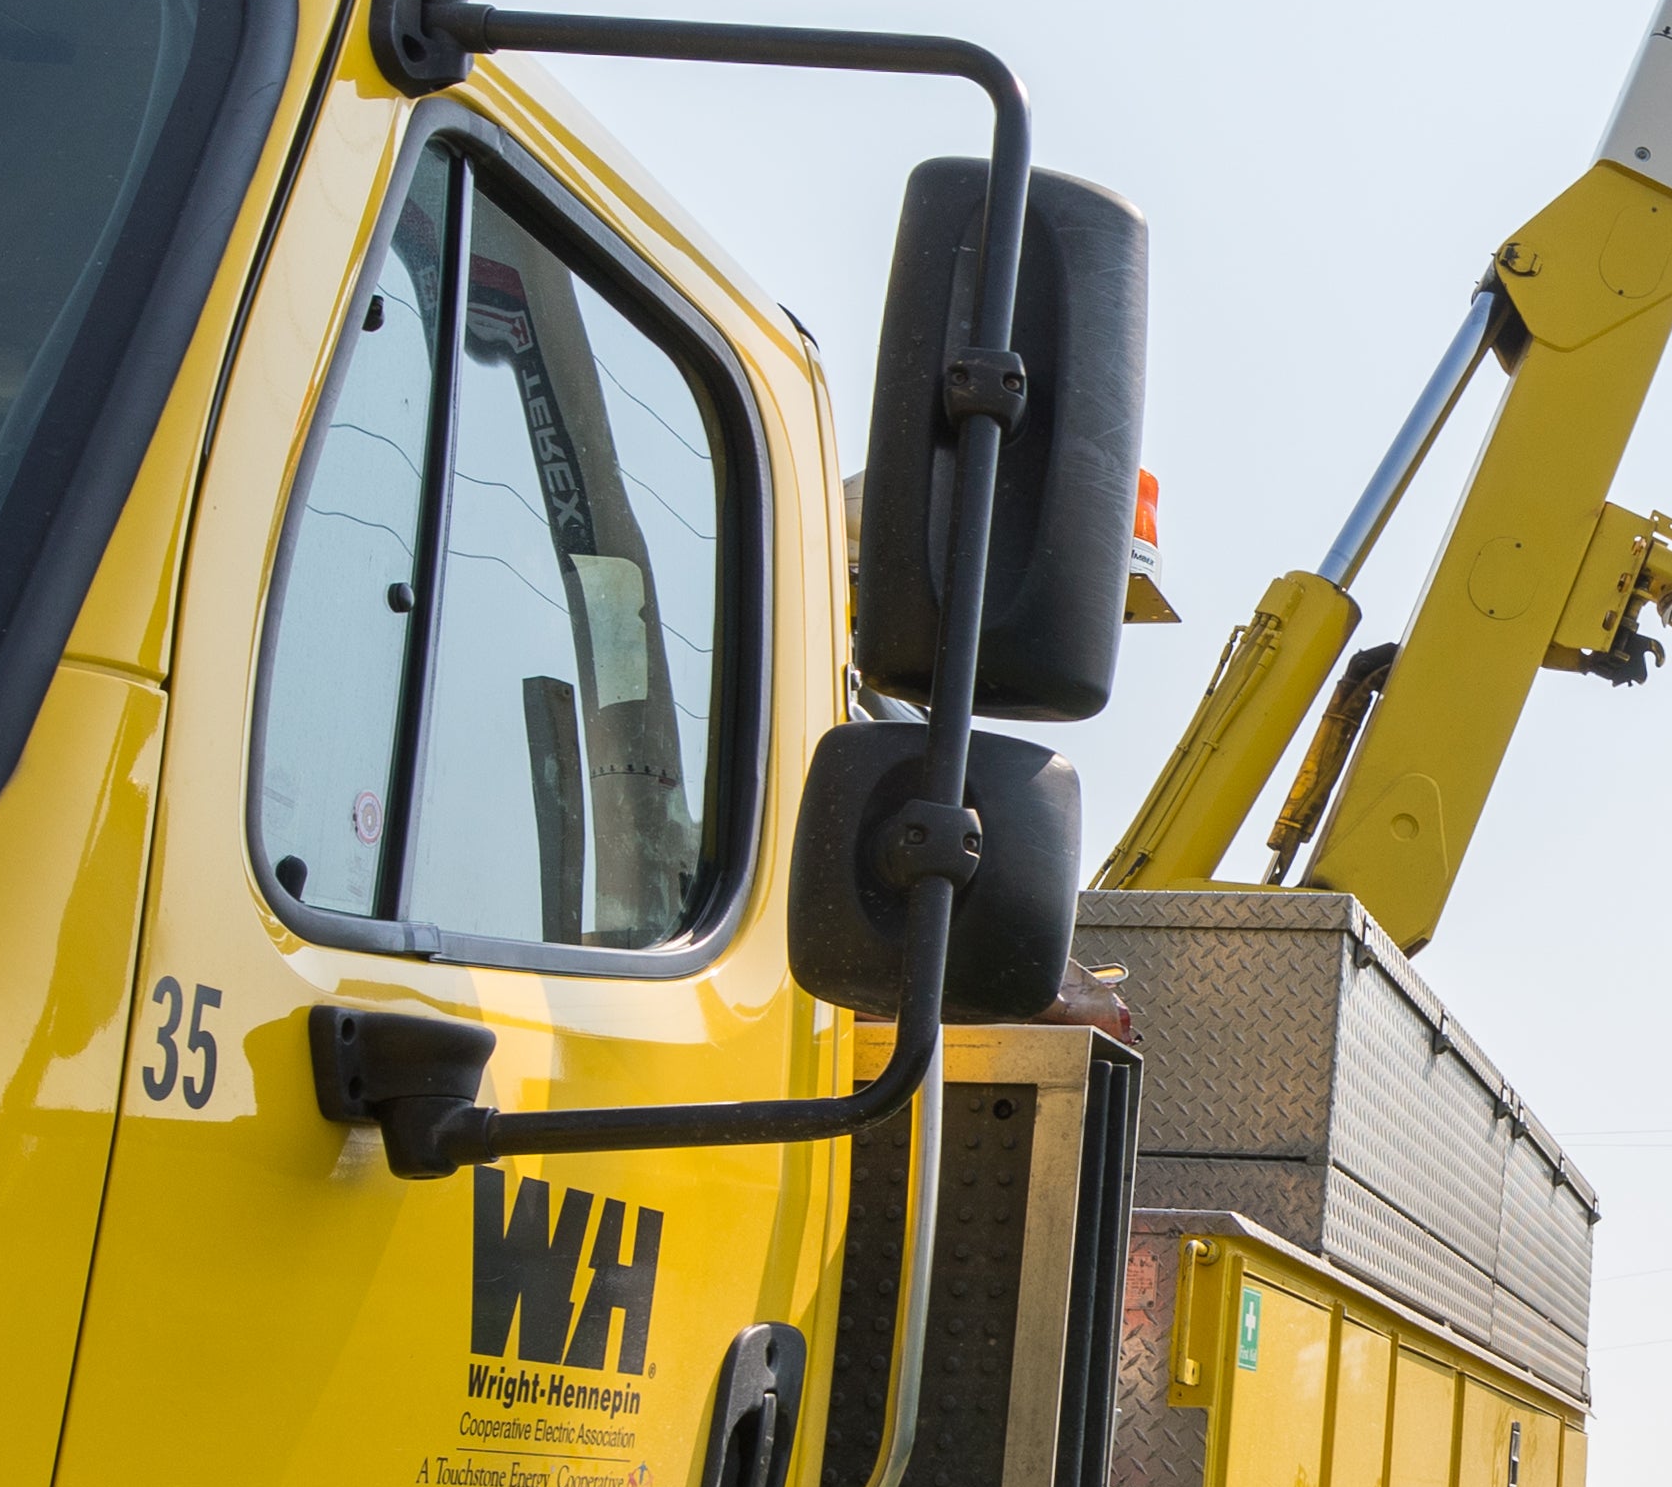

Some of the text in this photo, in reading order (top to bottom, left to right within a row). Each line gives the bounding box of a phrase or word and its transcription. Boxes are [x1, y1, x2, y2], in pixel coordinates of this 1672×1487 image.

[142, 975, 223, 1110] 35
[470, 1165, 665, 1376] WH
[467, 1363, 641, 1419] Wright-Hennepin
[459, 1411, 636, 1449] Cooperative Electric Association
[416, 1457, 430, 1484] A
[436, 1457, 506, 1487] Touchstone
